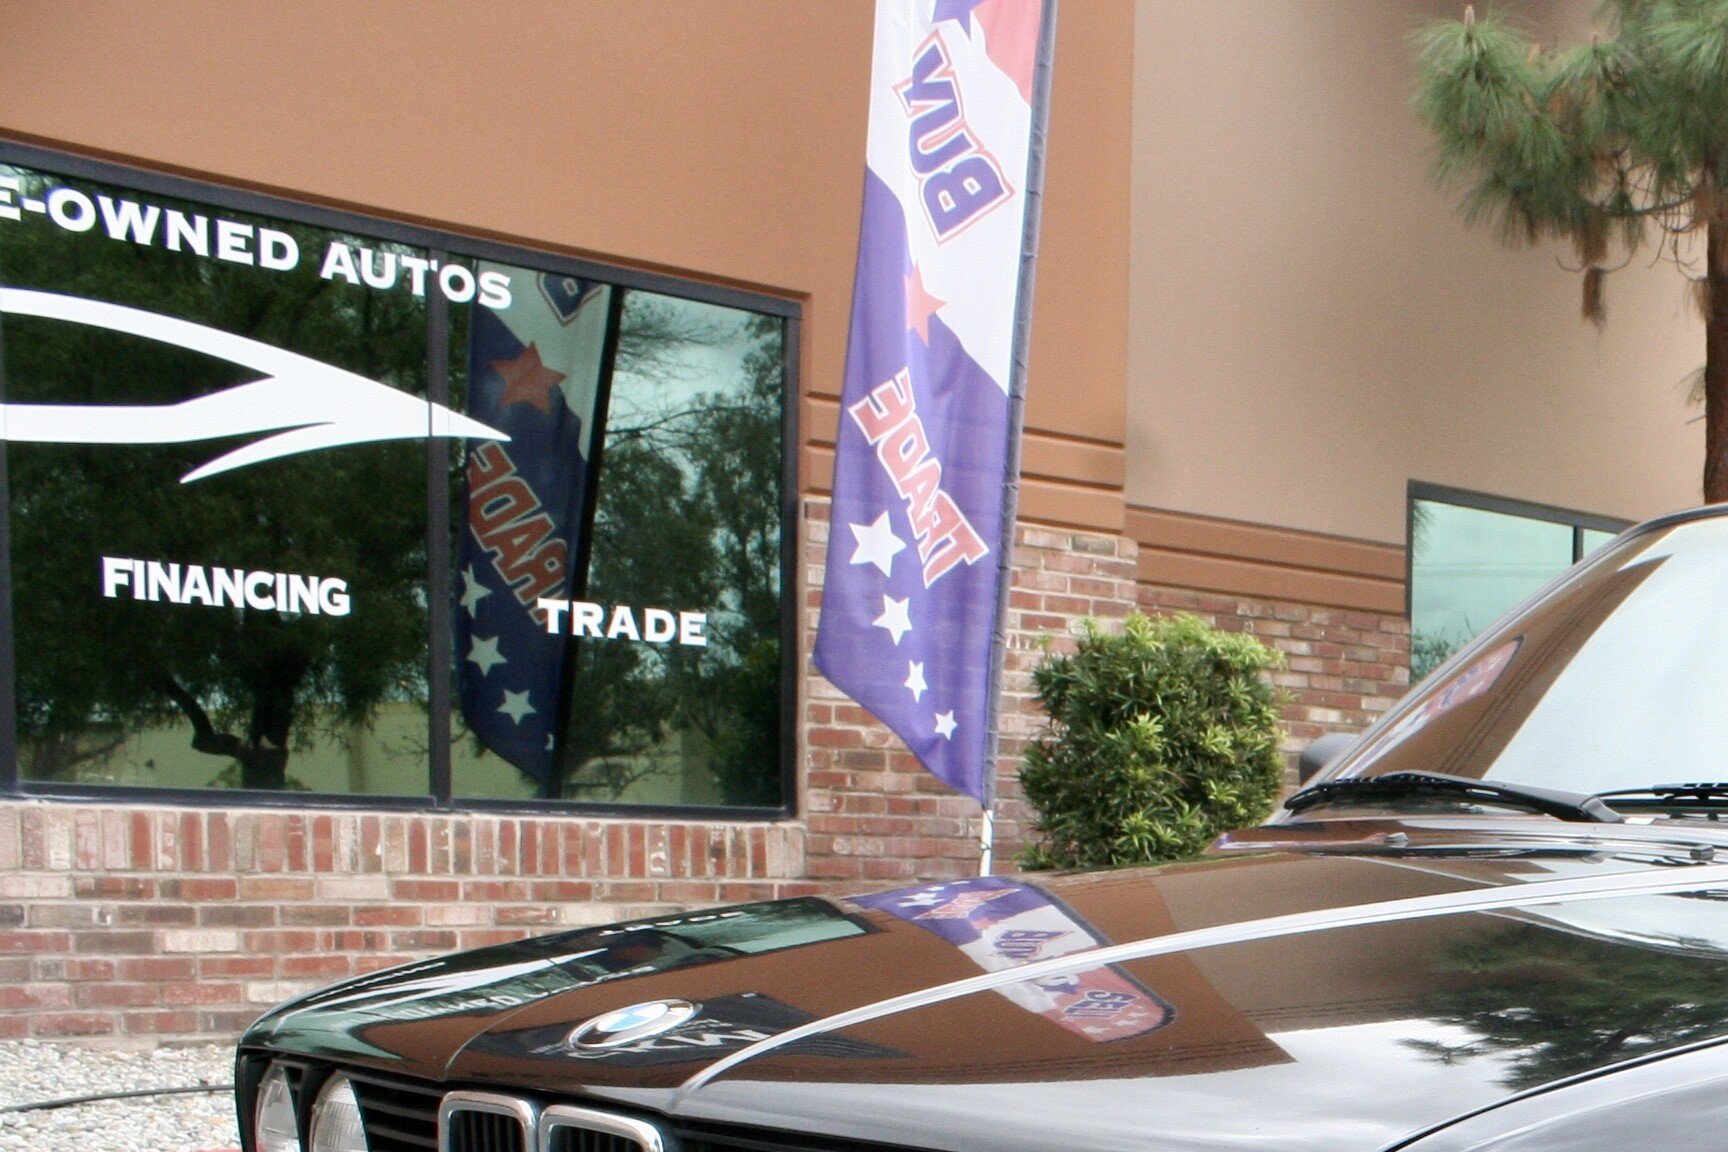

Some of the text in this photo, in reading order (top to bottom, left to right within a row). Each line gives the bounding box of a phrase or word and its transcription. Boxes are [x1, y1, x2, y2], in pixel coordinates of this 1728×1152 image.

[320, 241, 513, 310] AUTOS
[100, 556, 352, 617] FINANCING
[537, 597, 708, 647] TRADE
